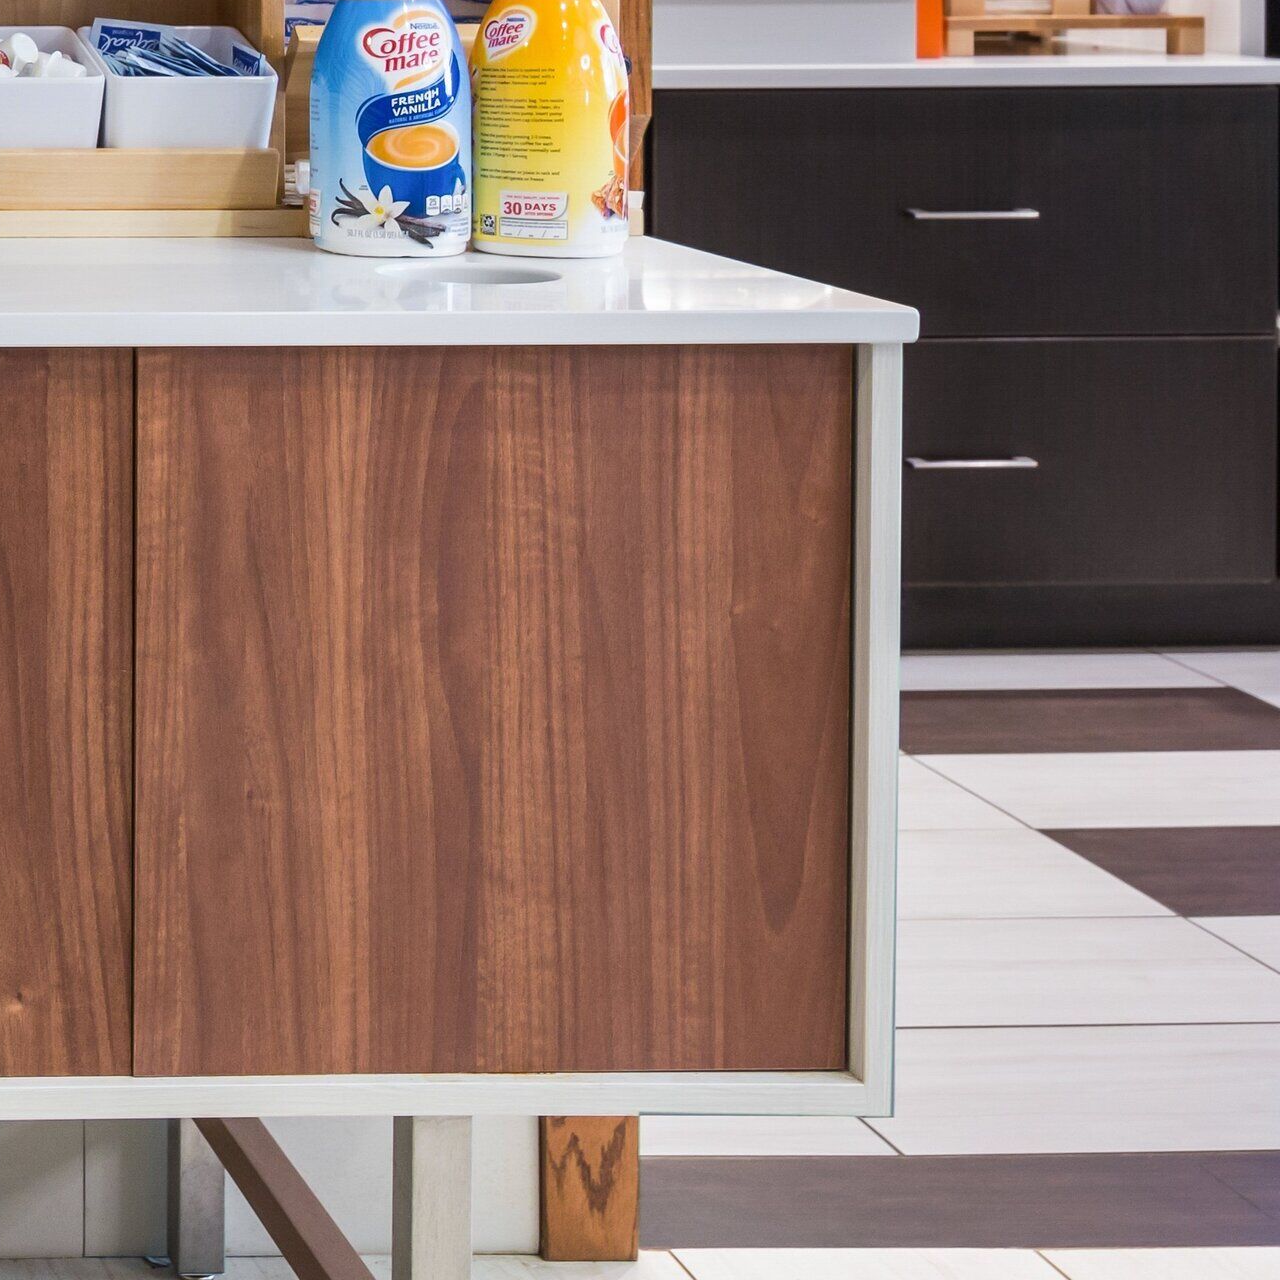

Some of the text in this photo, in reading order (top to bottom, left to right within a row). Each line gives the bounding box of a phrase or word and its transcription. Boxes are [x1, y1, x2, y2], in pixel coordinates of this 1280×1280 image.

[484, 20, 524, 40] Coffee
[362, 28, 441, 59] Coffee
[487, 33, 520, 49] mate
[390, 87, 440, 108] FRENCH
[392, 97, 442, 117] VANILLA
[503, 201, 557, 216] 30 DAYS
